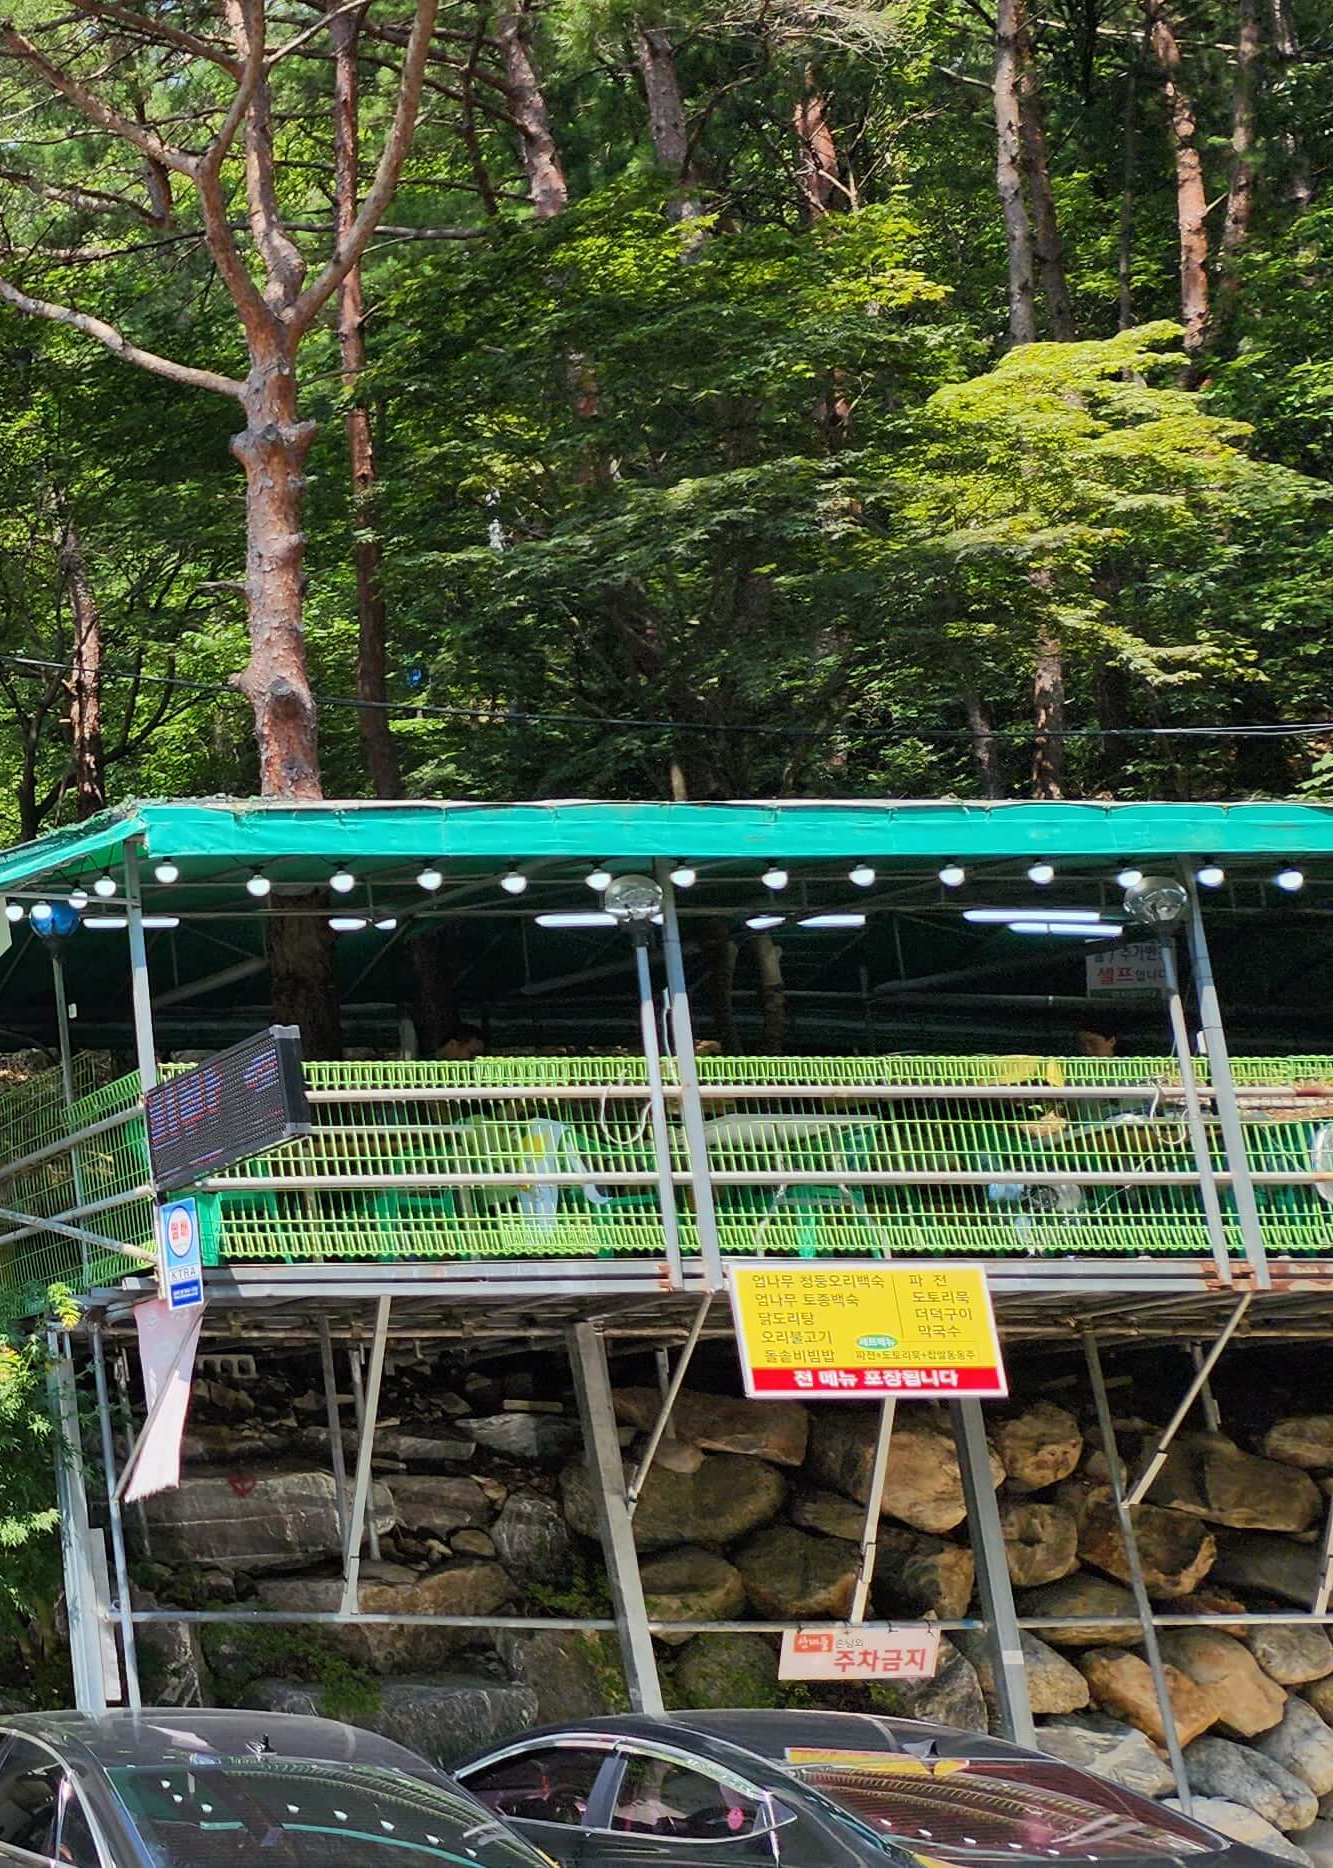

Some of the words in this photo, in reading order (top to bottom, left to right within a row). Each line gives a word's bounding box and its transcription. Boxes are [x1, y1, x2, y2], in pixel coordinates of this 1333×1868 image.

[752, 1274, 794, 1289] 엄나무
[755, 1293, 798, 1307] 엄나무
[804, 1293, 860, 1307] 토종백숙
[912, 1291, 970, 1304] 도토리묵
[758, 1311, 815, 1326] 닭도리탕
[916, 1307, 973, 1321] 더덕구이
[761, 1330, 833, 1345] 오리불고기
[918, 1325, 962, 1338] 막국수
[793, 1369, 814, 1388] 전
[818, 1369, 858, 1389] 메뉴
[863, 1369, 959, 1388] 포장됩니다
[834, 1648, 926, 1672] 주차금지
